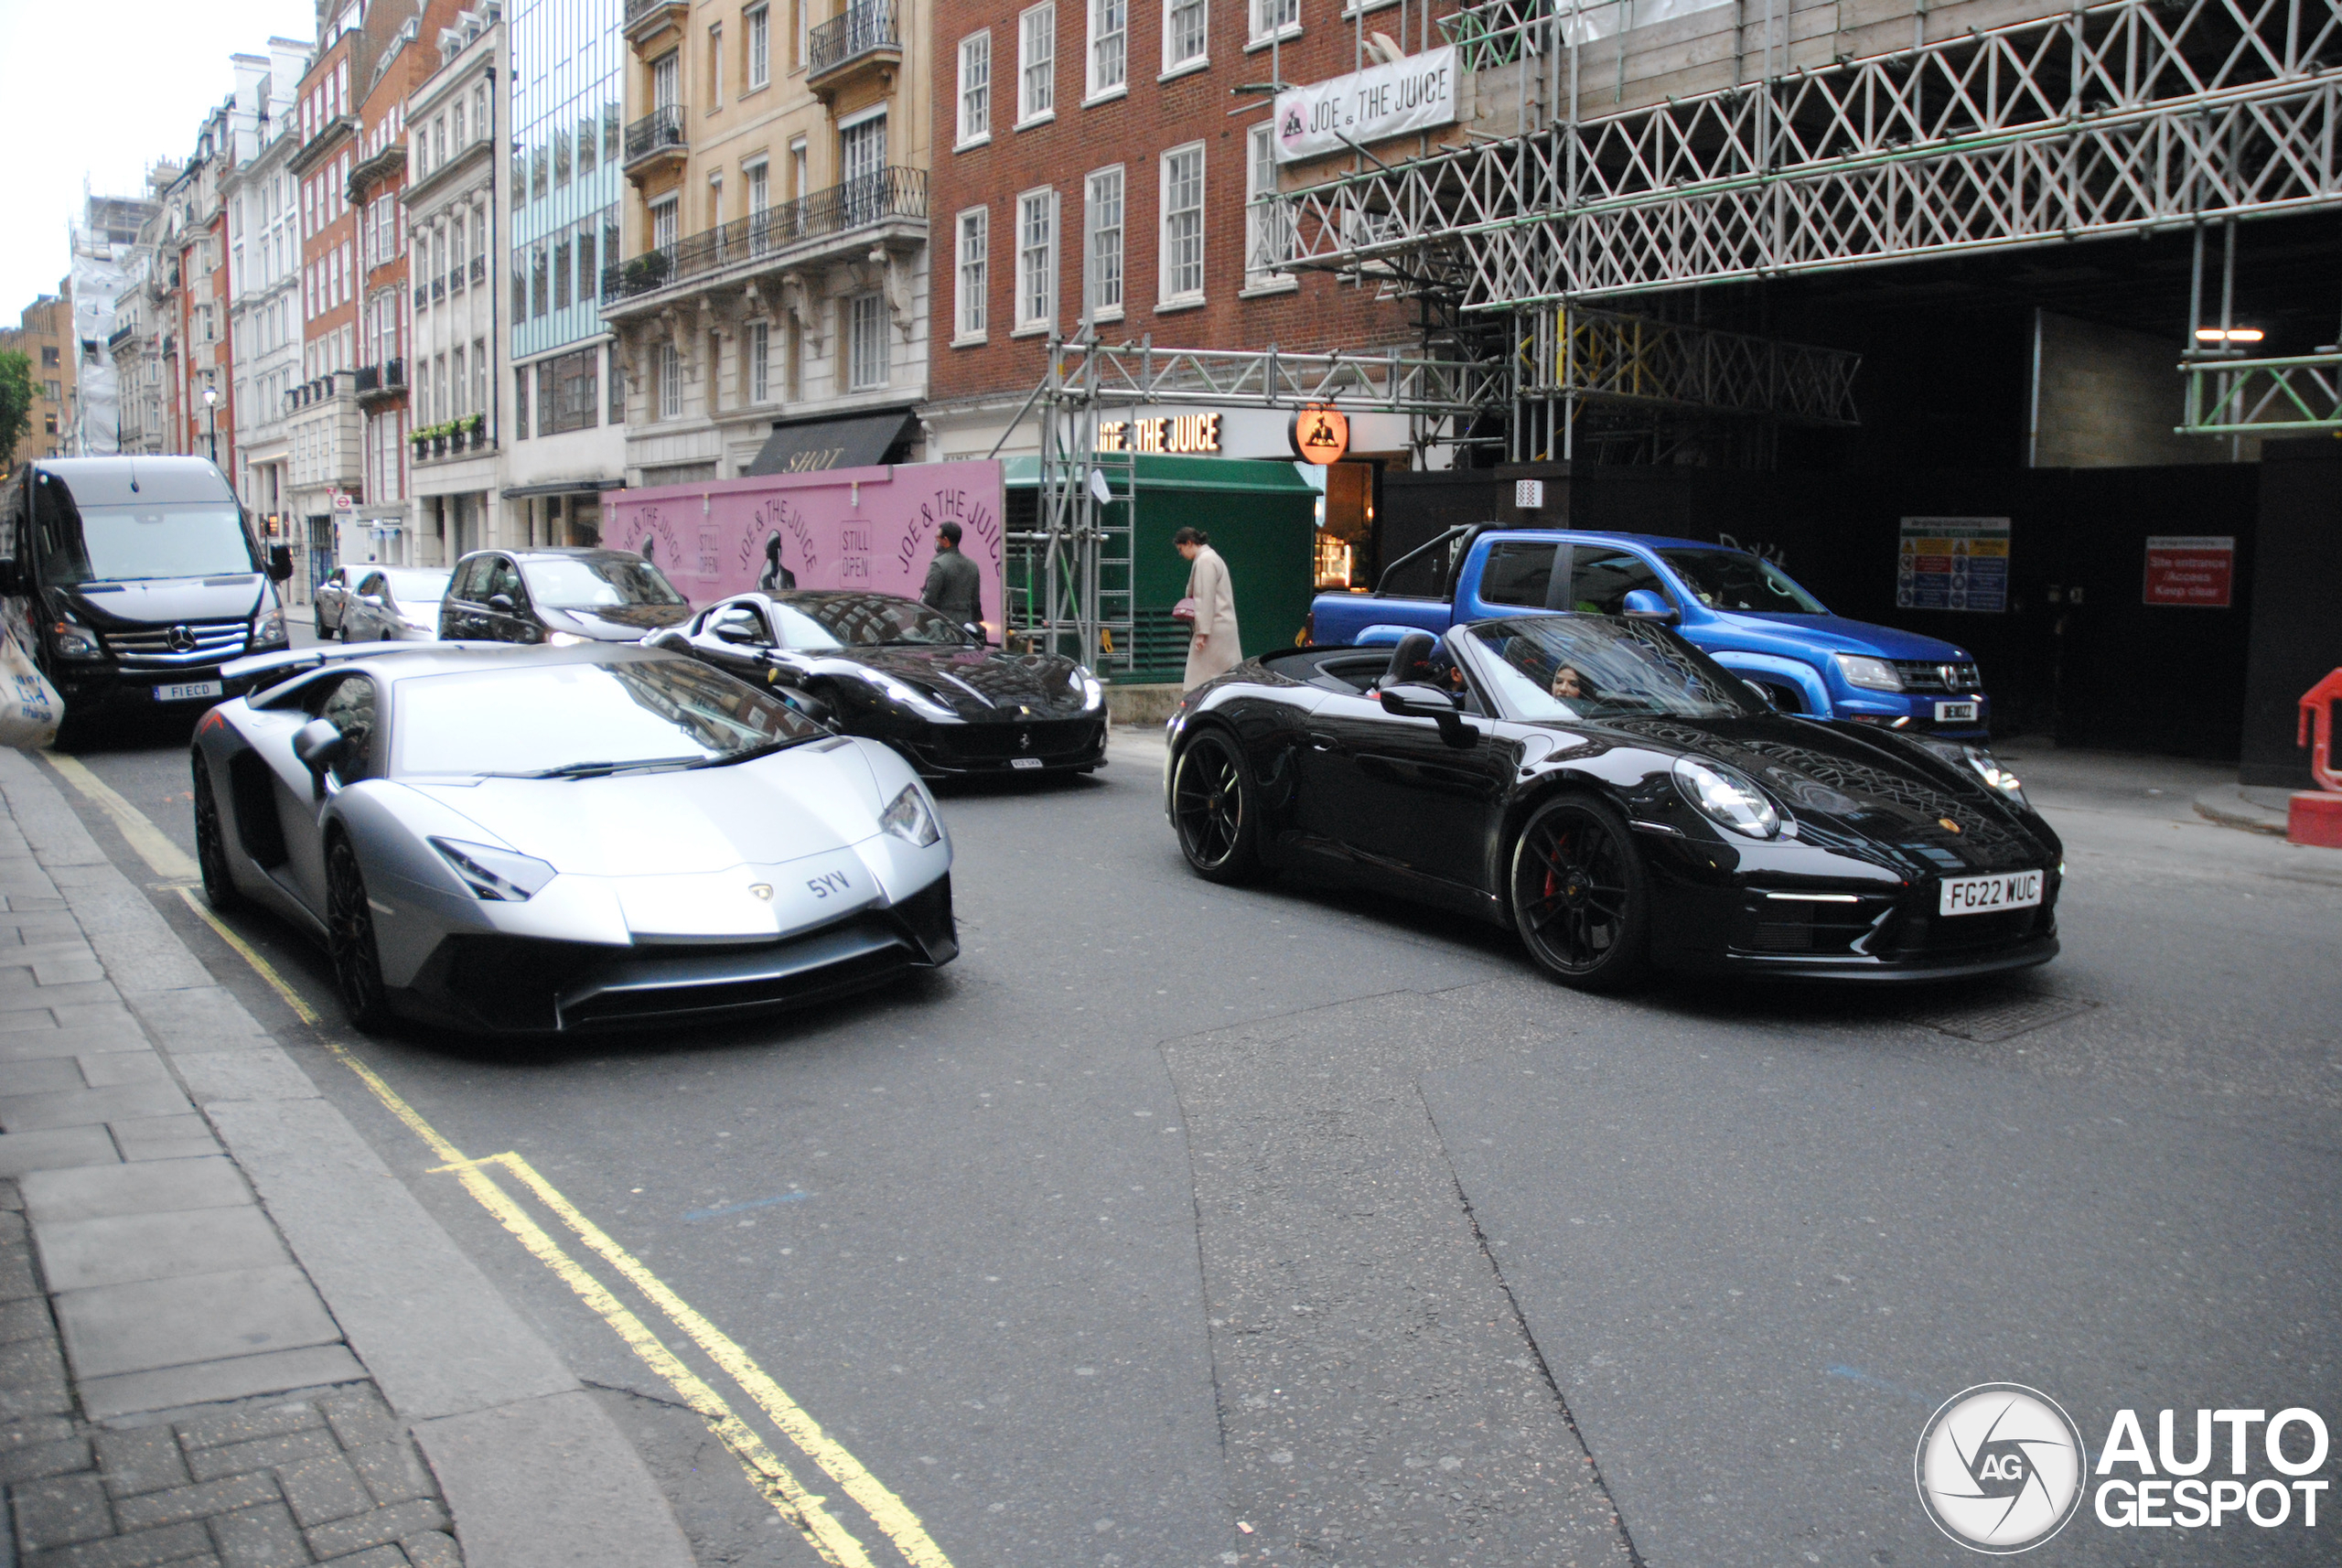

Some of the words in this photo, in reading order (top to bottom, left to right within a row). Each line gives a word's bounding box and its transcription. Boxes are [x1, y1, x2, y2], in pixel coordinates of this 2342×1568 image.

[1311, 98, 1340, 133] JOE
[1346, 115, 1354, 124] &
[1359, 83, 1391, 121] THE
[1395, 69, 1447, 112] JUICE
[1134, 417, 1166, 453] THE
[1169, 412, 1219, 453] JUICE
[783, 447, 844, 474] SHOT
[641, 506, 658, 528] THE
[658, 515, 682, 570] JUICE
[699, 533, 718, 551] STILL
[738, 523, 757, 571] JOE
[755, 510, 765, 532] &
[765, 499, 788, 523] THE
[788, 509, 818, 573] JUICE
[842, 531, 869, 551] STILL
[898, 518, 921, 575] JOE
[920, 502, 934, 529] &
[934, 489, 966, 519] THE
[699, 555, 718, 575] OPEN
[842, 557, 869, 577] OPEN
[2150, 556, 2173, 567] Site
[2175, 559, 2227, 568] entrance
[2154, 585, 2186, 598] Keep
[2187, 587, 2218, 596] clear
[1951, 880, 2002, 908] FG22
[2006, 875, 2036, 902] WUC
